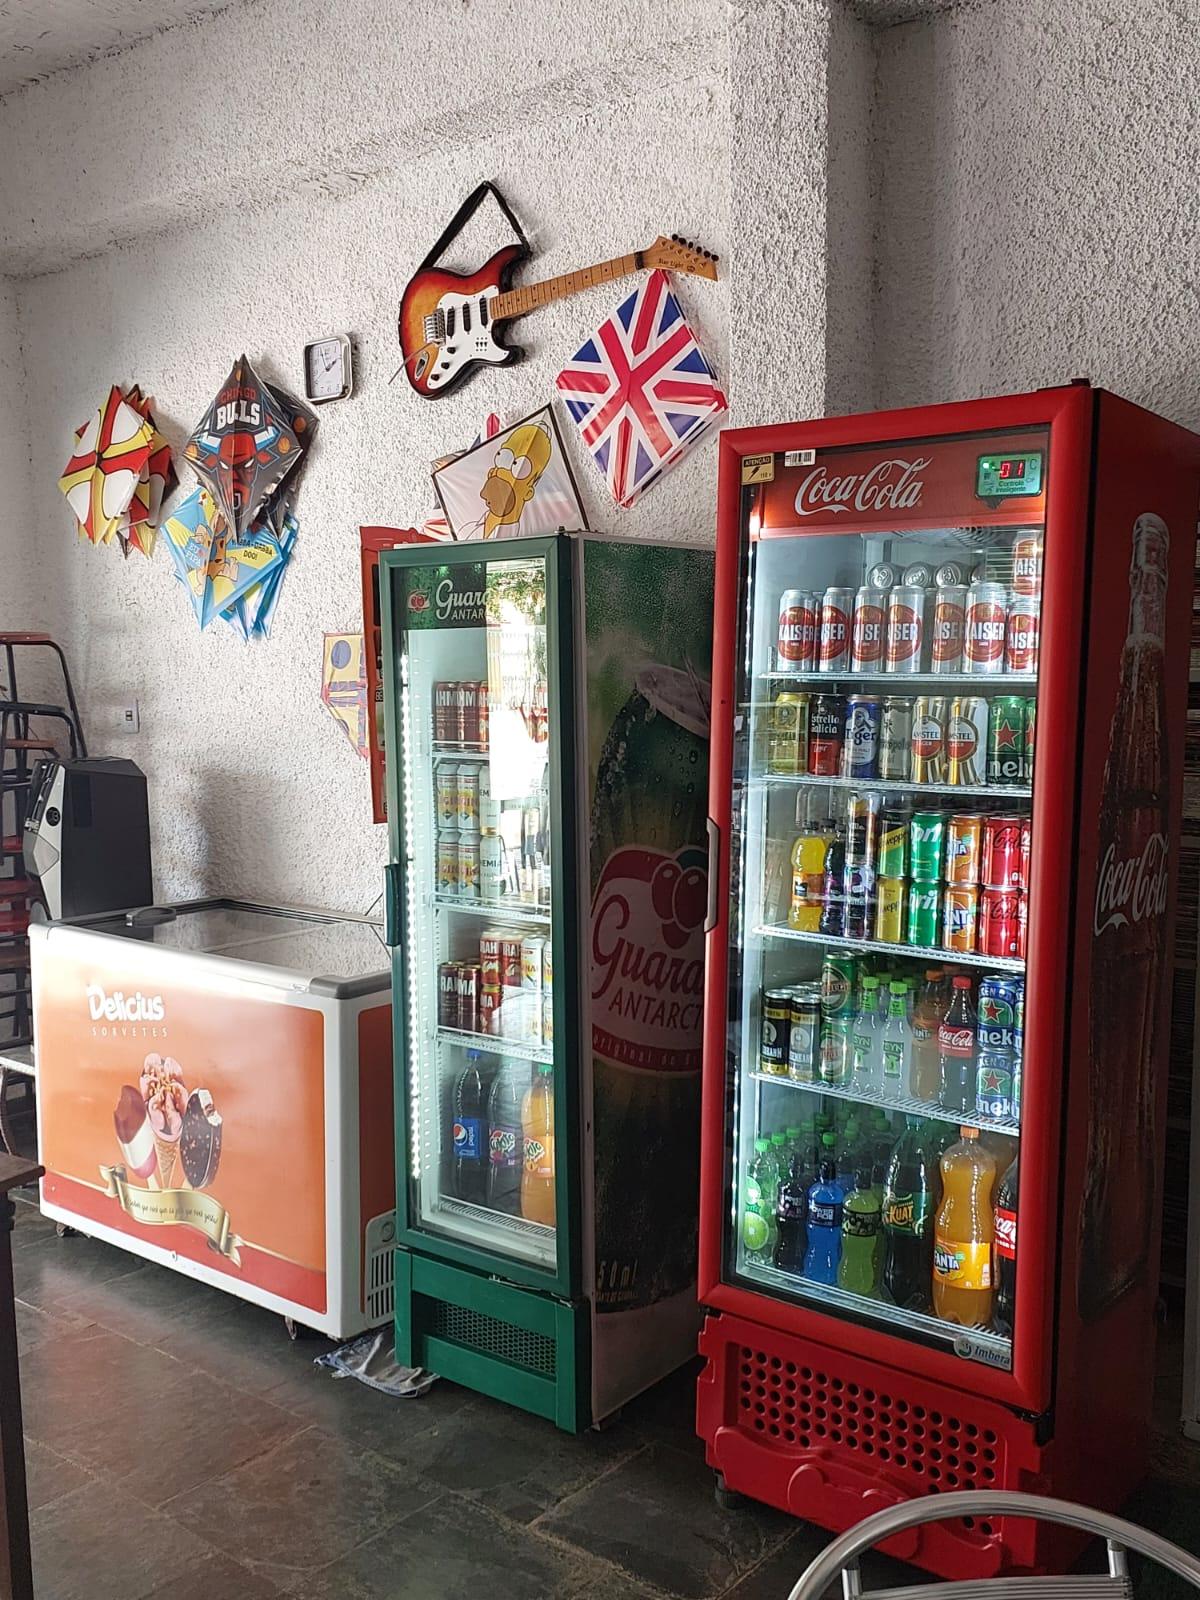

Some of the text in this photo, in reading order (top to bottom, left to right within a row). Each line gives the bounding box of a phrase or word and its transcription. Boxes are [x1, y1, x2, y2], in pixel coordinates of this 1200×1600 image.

[216, 399, 261, 430] BULLS
[795, 455, 934, 516] Coca-Cola
[779, 624, 814, 641] KAISER
[845, 725, 877, 746] Tger
[1094, 832, 1169, 937] Coca-Cola
[86, 984, 165, 1021] Delicius
[92, 1026, 168, 1038] SORVETES
[888, 1204, 914, 1223] KUAT
[934, 1250, 960, 1270] FANTA
[974, 1345, 1010, 1366] Imbera
